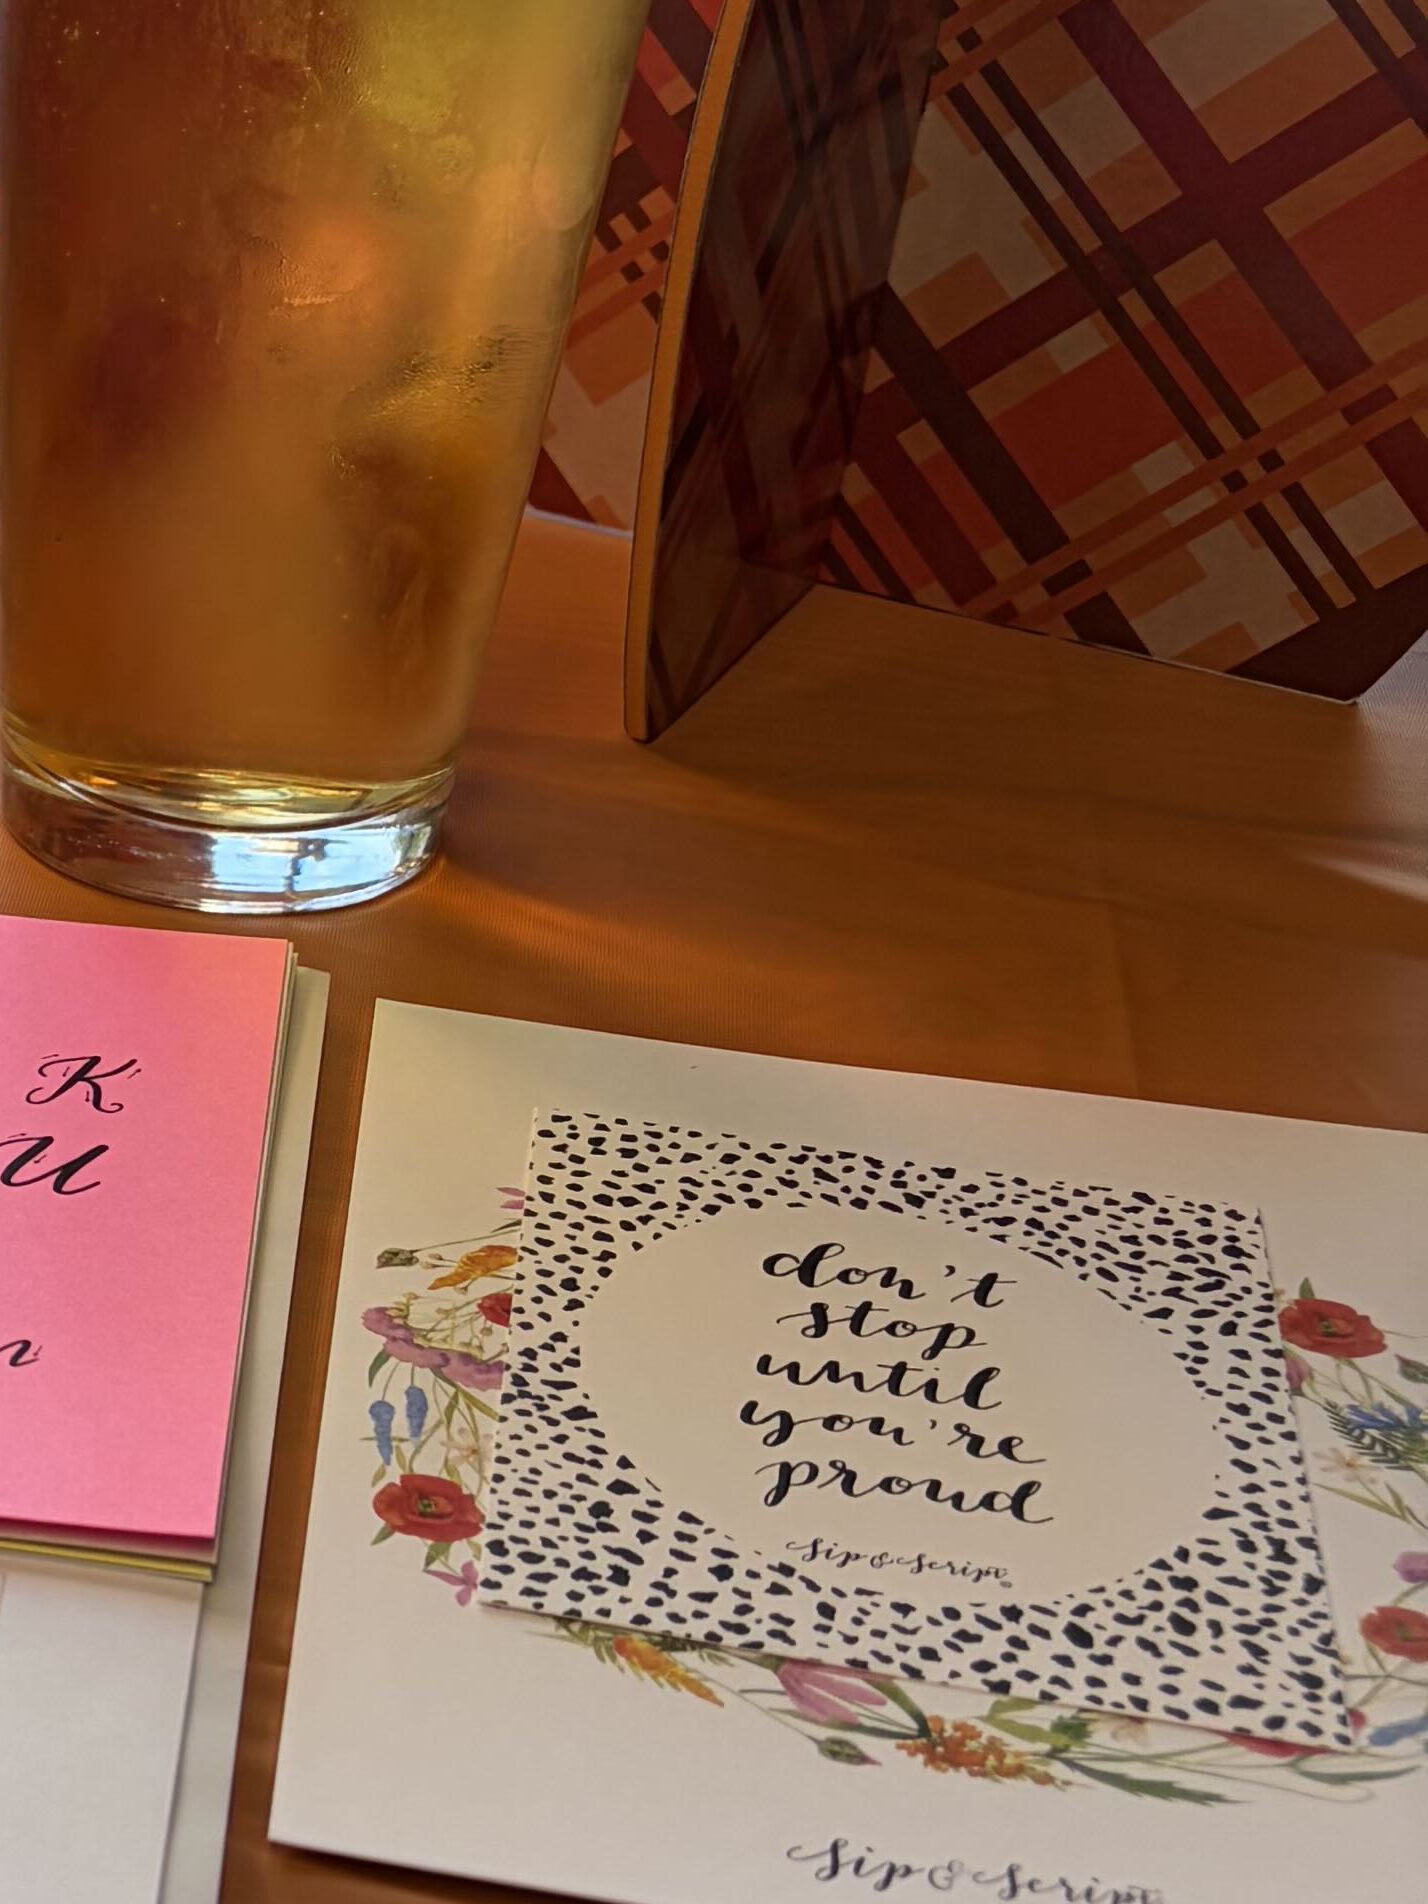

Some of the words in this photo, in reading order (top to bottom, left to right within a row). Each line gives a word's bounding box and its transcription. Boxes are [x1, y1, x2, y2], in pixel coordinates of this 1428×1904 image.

[25, 1055, 139, 1114] K
[762, 1242, 1019, 1308] don't
[776, 1300, 988, 1361] stop
[756, 1353, 1003, 1411] until
[739, 1399, 1047, 1464] you're
[754, 1459, 1055, 1525] proud
